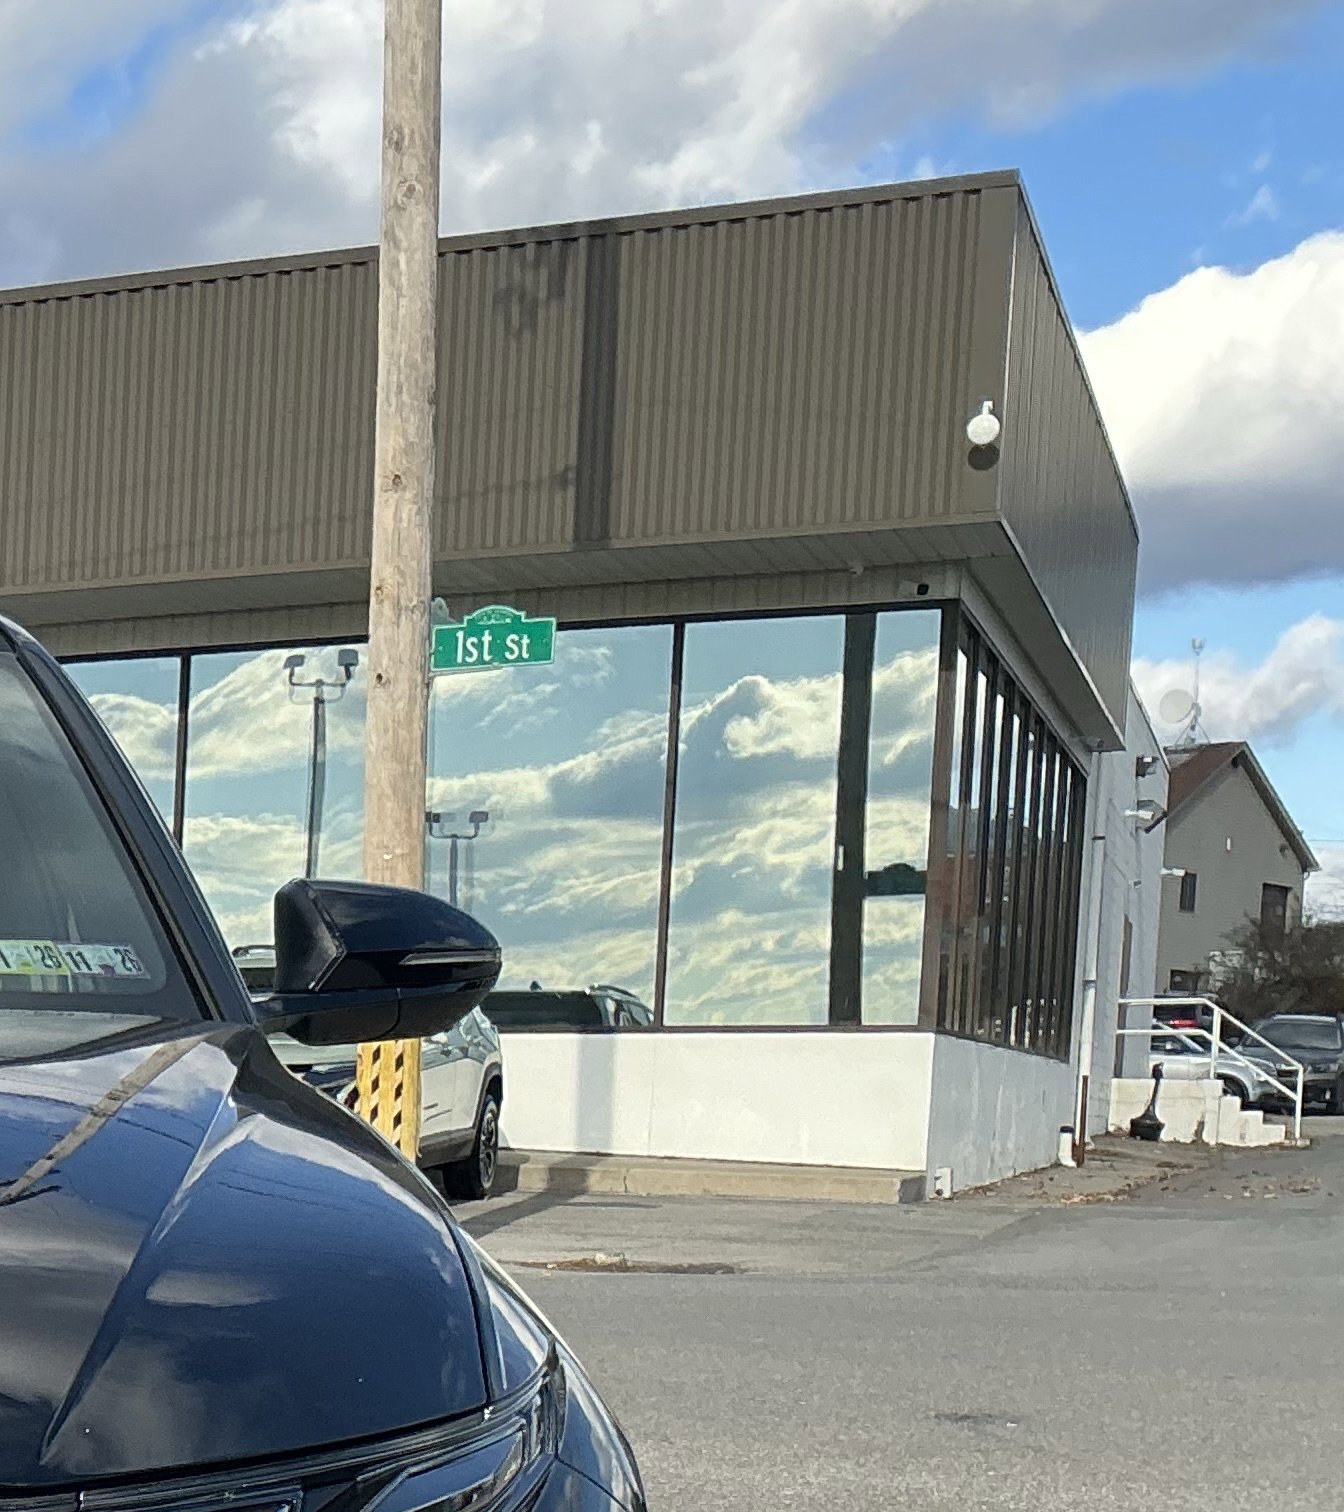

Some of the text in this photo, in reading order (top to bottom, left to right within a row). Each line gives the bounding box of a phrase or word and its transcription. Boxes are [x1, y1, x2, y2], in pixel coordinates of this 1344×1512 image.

[456, 629, 531, 664] 1st St
[65, 950, 93, 972] 11
